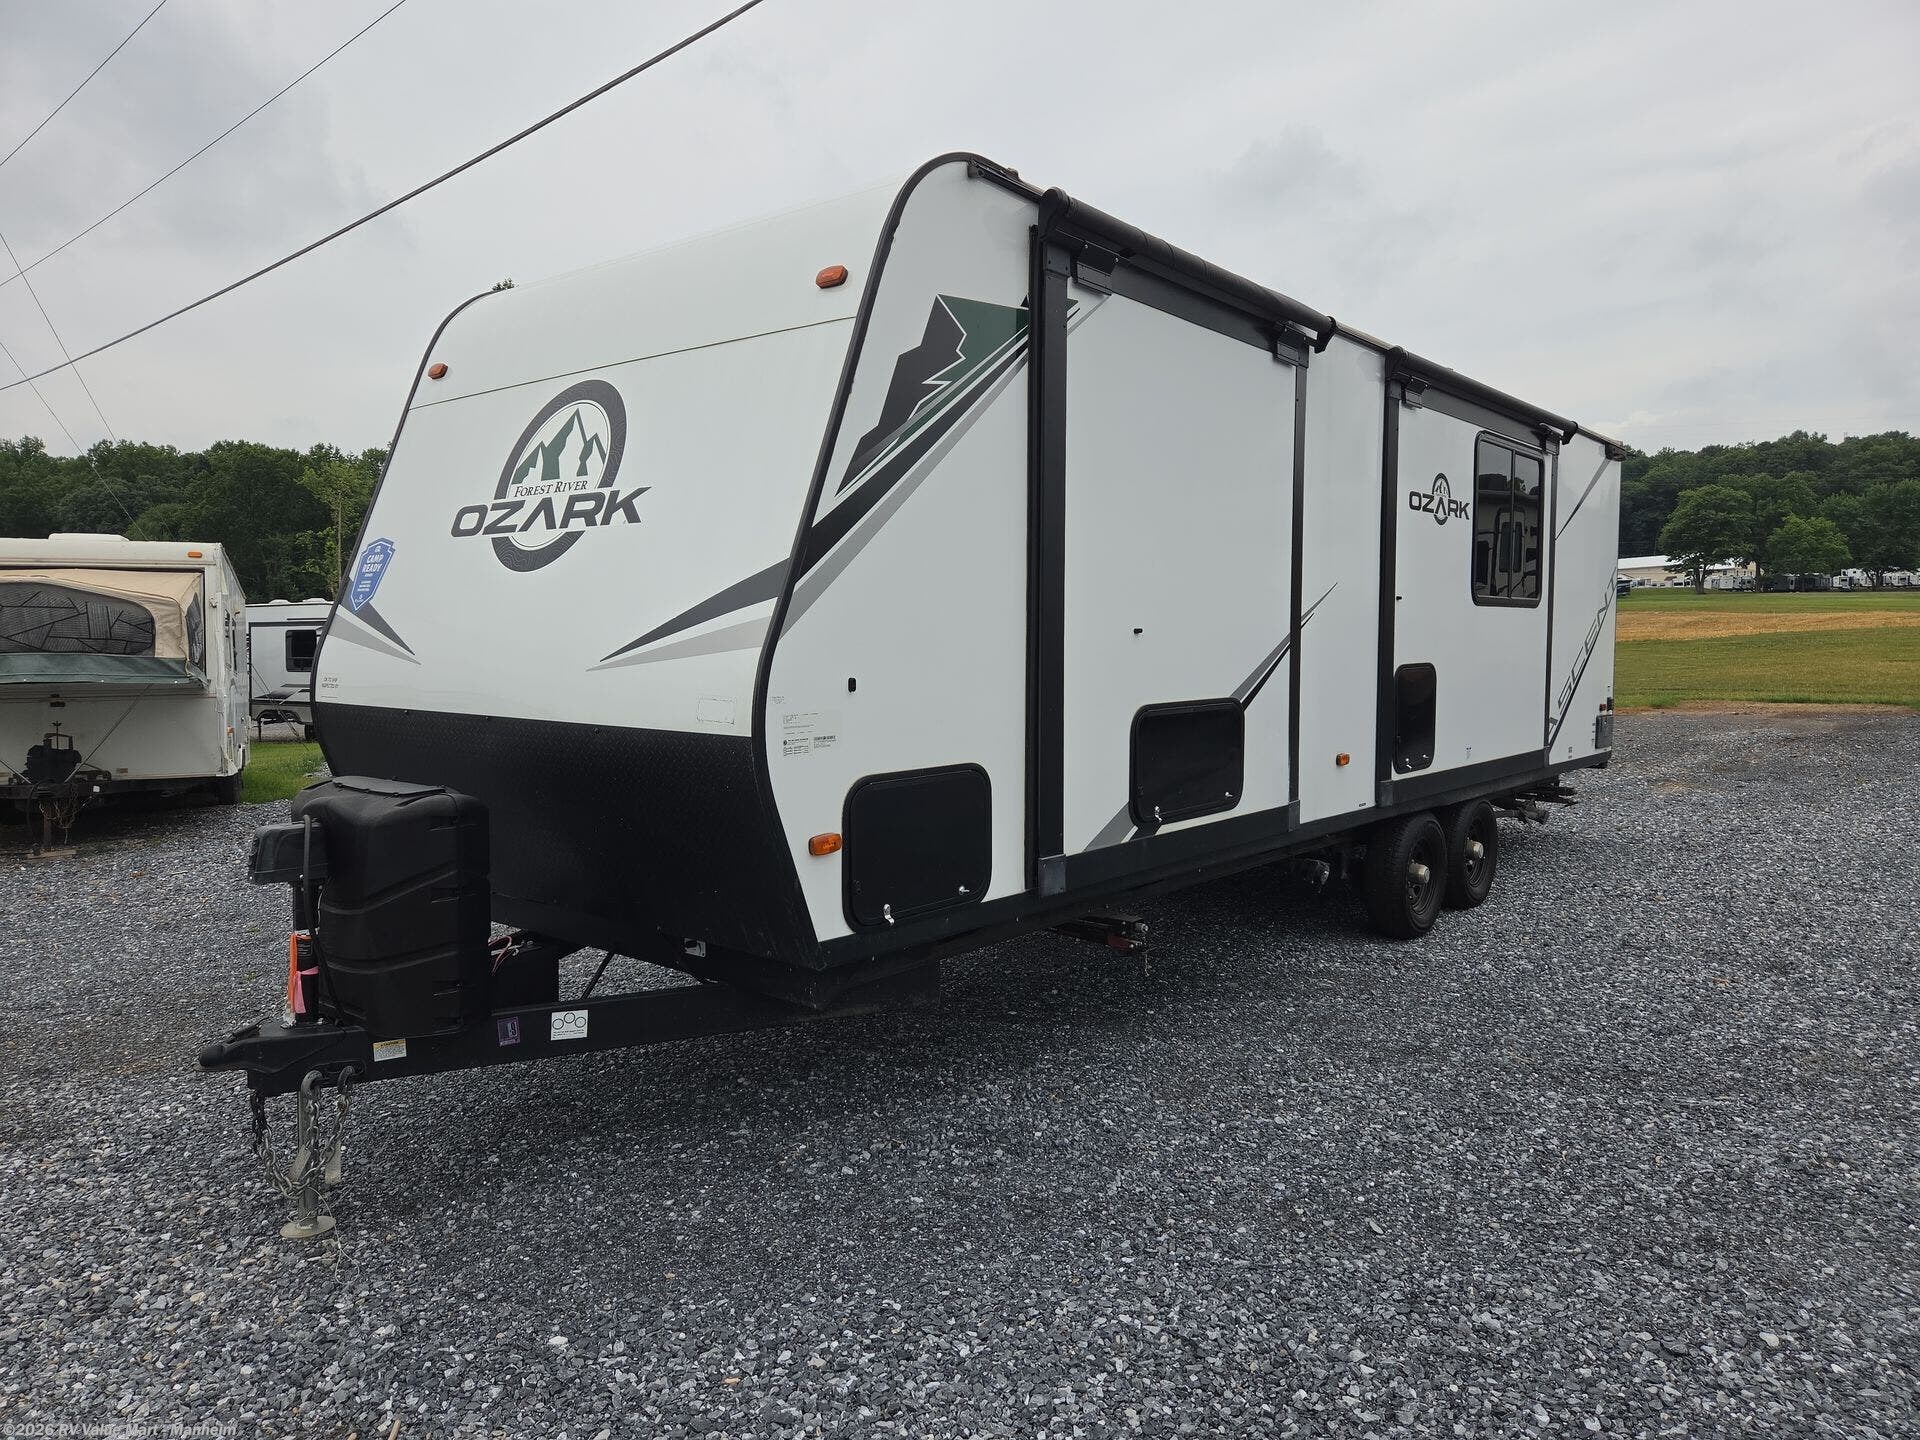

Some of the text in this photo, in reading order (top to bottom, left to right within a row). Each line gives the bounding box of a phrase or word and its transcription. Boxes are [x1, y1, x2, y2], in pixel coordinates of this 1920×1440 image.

[514, 480, 588, 497] FOREST RIVER
[450, 486, 652, 538] OZARK
[1409, 491, 1470, 520] OZARK
[366, 554, 384, 563] CAMP
[361, 563, 383, 573] READY
